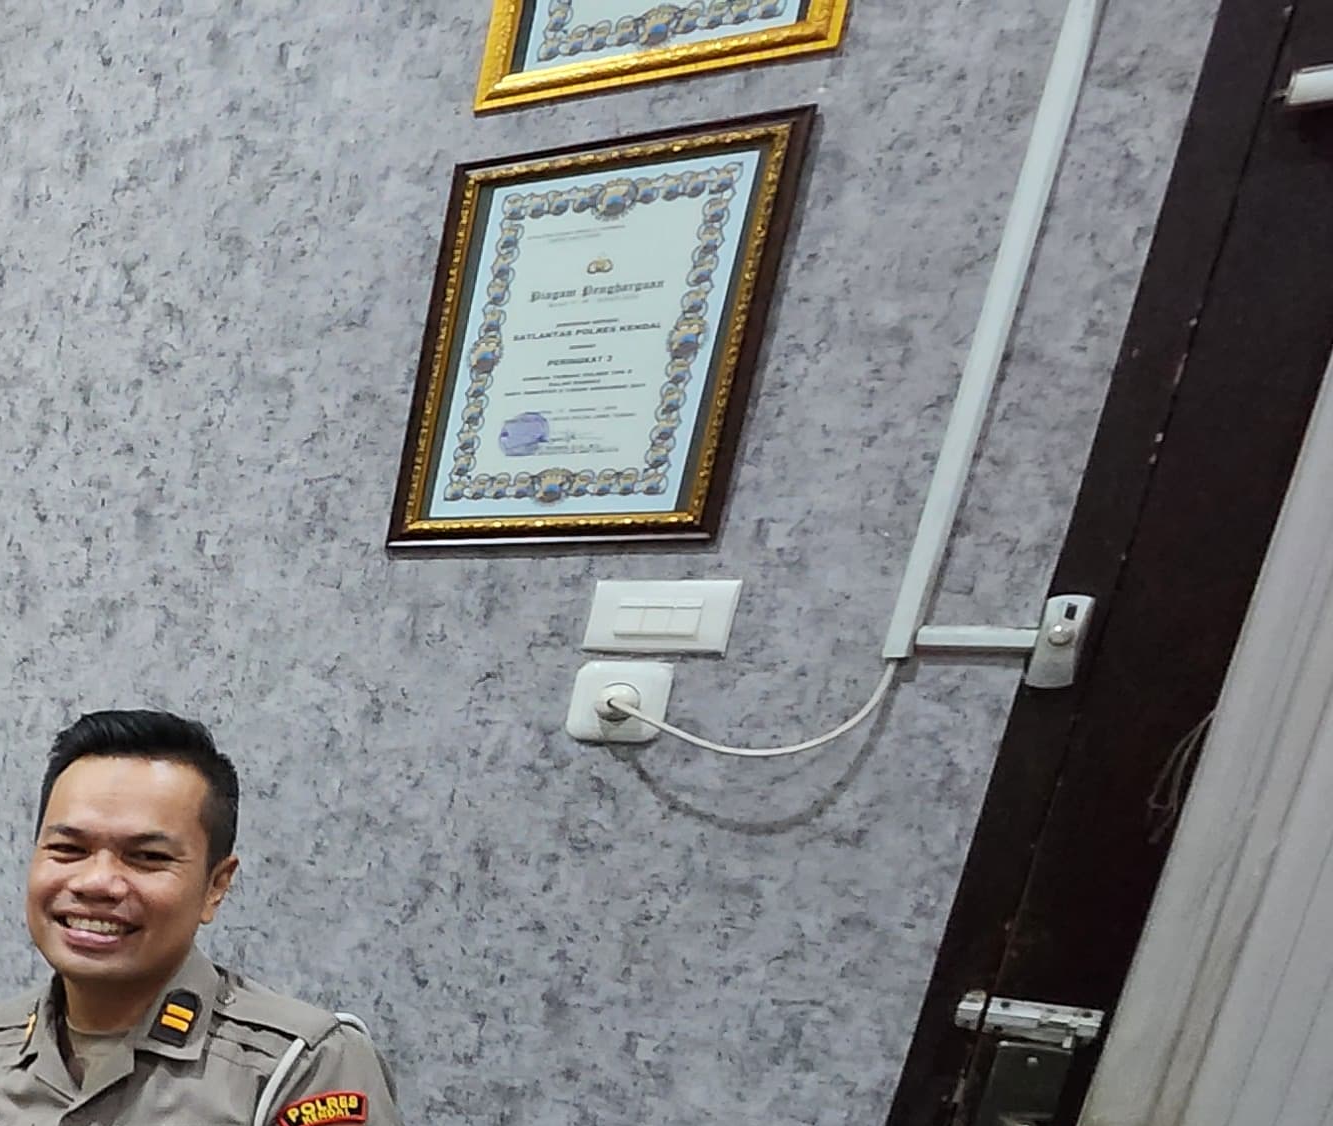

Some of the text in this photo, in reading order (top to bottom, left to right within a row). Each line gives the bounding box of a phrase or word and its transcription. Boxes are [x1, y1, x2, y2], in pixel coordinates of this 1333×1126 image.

[513, 330, 572, 342] SATLANTAS
[575, 326, 616, 336] POLRES
[619, 322, 662, 332] KENDAL
[286, 1095, 358, 1123] POLRES
